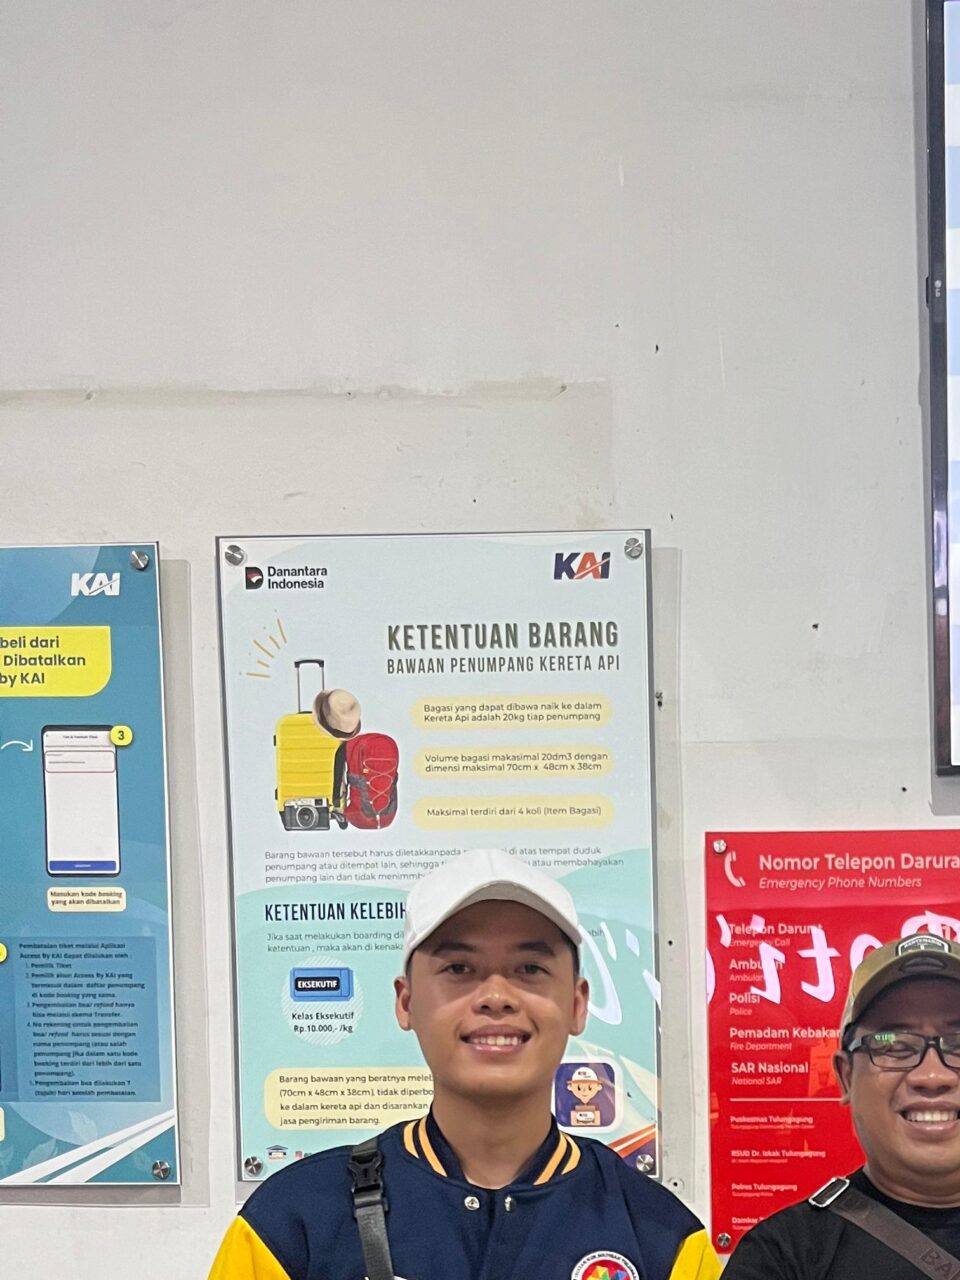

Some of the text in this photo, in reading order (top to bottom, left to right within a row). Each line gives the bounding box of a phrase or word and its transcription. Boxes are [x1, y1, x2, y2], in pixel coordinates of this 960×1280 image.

[553, 552, 611, 580] KAI
[267, 566, 328, 578] Danantara
[71, 573, 120, 596] KAI
[267, 578, 324, 590] Indonesia
[387, 621, 619, 651] KETENTUAN BARANG
[30, 635, 59, 649] dari
[4, 654, 86, 667] Dibatalkan
[387, 655, 621, 675] BAWAAN PENUMPANG KERETA API
[20, 673, 45, 684] KAI
[424, 702, 602, 714] Bagasi yang dapat dibawa naik dalam
[424, 713, 601, 723] Kereta Api adalah 20kg tiap penumpang
[118, 730, 125, 741] 3
[425, 752, 608, 764] Volume bagasi makasimal 20dm3 dengan
[425, 762, 602, 773] dimensi maksimal 70cm 48cm 38cm
[427, 806, 602, 817] Maksimal terdiri dari (Item Bagasi)
[539, 847, 601, 857] tempat duduk
[553, 858, 624, 868] membahayakan
[759, 855, 821, 871] Nomor
[824, 854, 895, 873] Telepon
[759, 876, 922, 891] Emergency Phone Numbers
[265, 903, 345, 922] KETENTUAN
[304, 931, 392, 941] melakukan boarding
[297, 980, 337, 989] EKSEKUTIF
[729, 992, 760, 1004] Polisi
[292, 1011, 354, 1021] Kelas Eksekutif
[730, 1008, 752, 1016] Police
[730, 1028, 789, 1039] Pemadam
[730, 1042, 792, 1051] Fire Department
[731, 1061, 808, 1074] SAR Nasional
[279, 1074, 406, 1085] Barang bawaan beratnya
[731, 1077, 782, 1085] National SAR
[377, 1088, 399, 1097] tidak
[383, 1102, 429, 1111] disarankan
[299, 1116, 346, 1126] pengiriman
